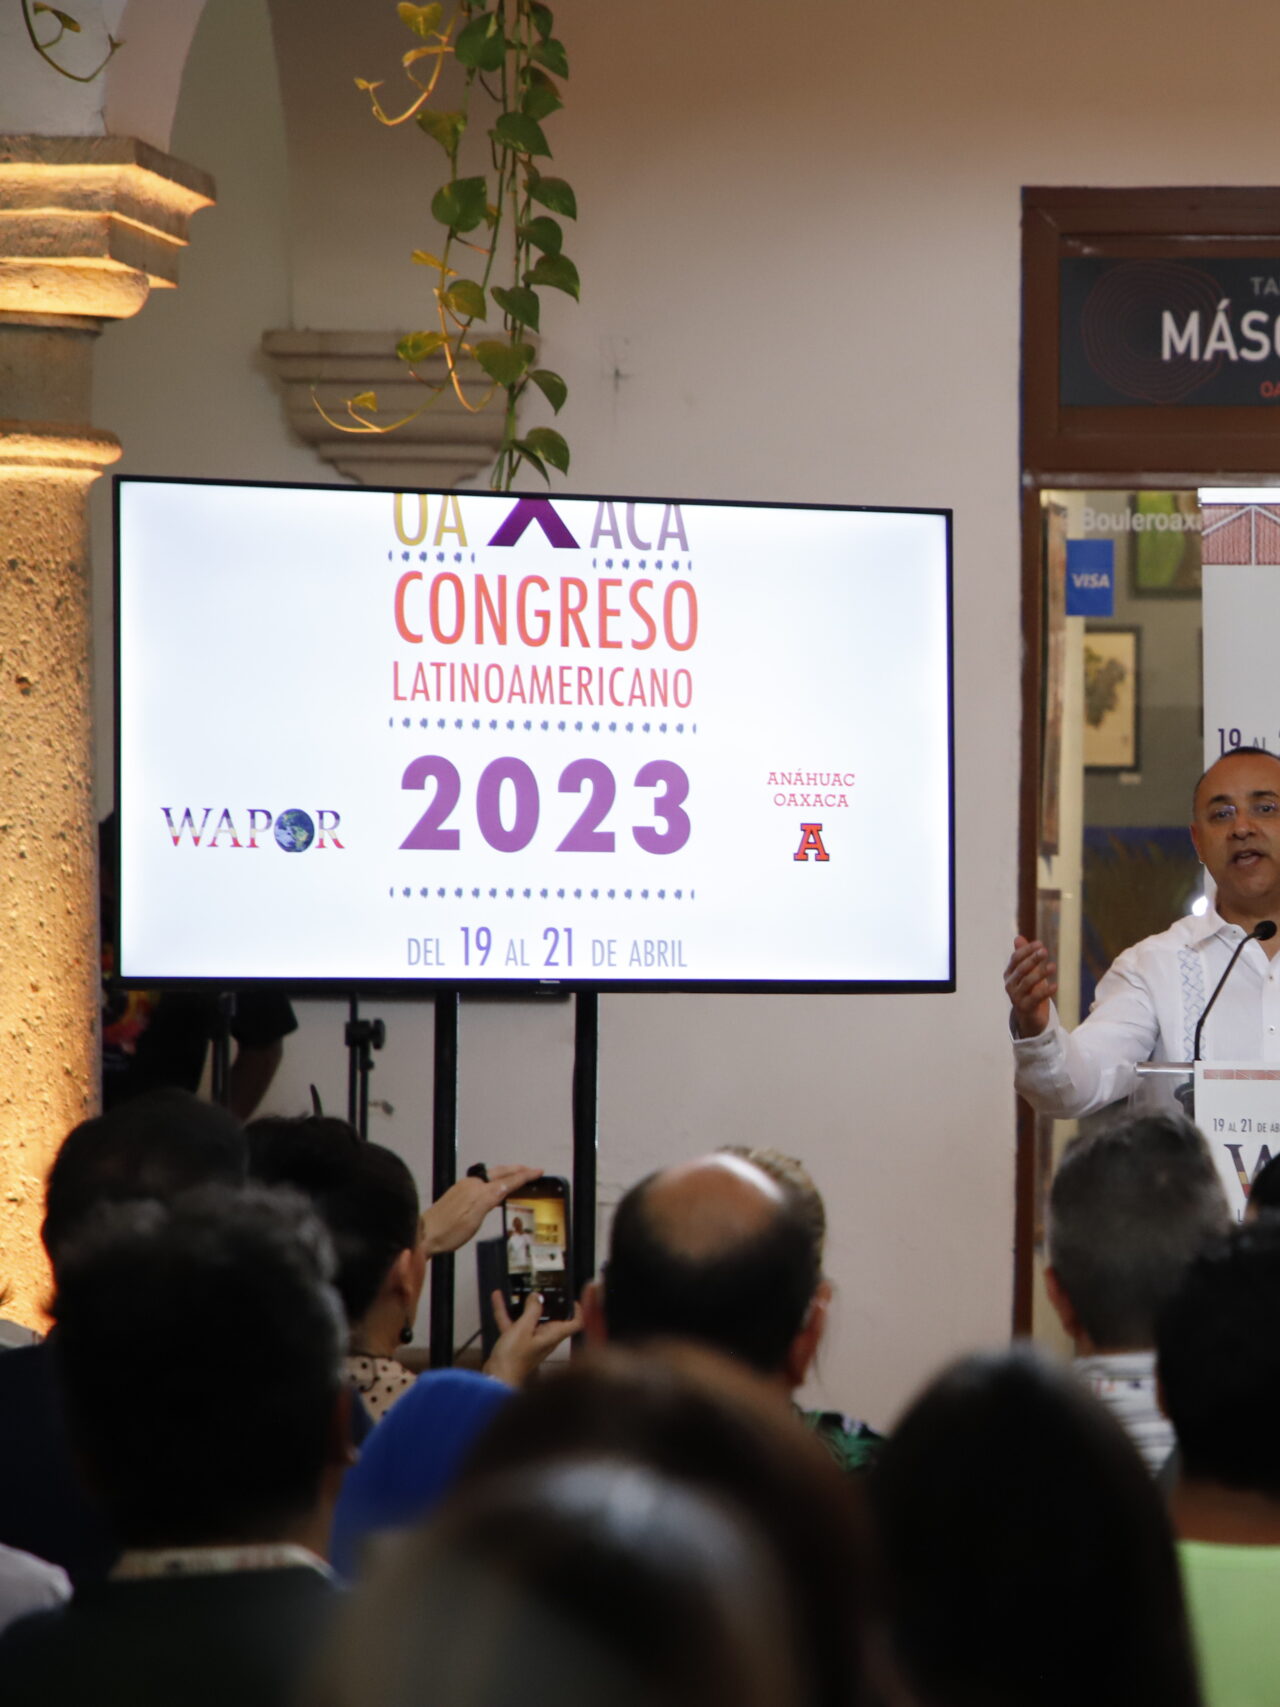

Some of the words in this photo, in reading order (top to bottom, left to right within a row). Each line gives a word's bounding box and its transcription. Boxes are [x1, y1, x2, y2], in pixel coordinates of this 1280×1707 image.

[1072, 573, 1110, 588] VISA
[394, 570, 698, 652] CONGRESO
[393, 661, 693, 709] LATINOAMERICANO
[1218, 728, 1241, 753] 19
[767, 768, 856, 787] ANÁHUAC
[398, 755, 691, 855] 2023
[773, 793, 849, 807] OAXACA
[793, 822, 830, 862] A
[407, 938, 445, 966] DEL
[460, 926, 492, 966] 19
[505, 939, 530, 967] AL
[542, 927, 573, 967] 21
[592, 939, 617, 967] DE
[628, 939, 688, 968] ABRIL
[1213, 1118, 1225, 1132] 19
[1241, 1118, 1252, 1132] 21
[1257, 1123, 1267, 1133] DE
